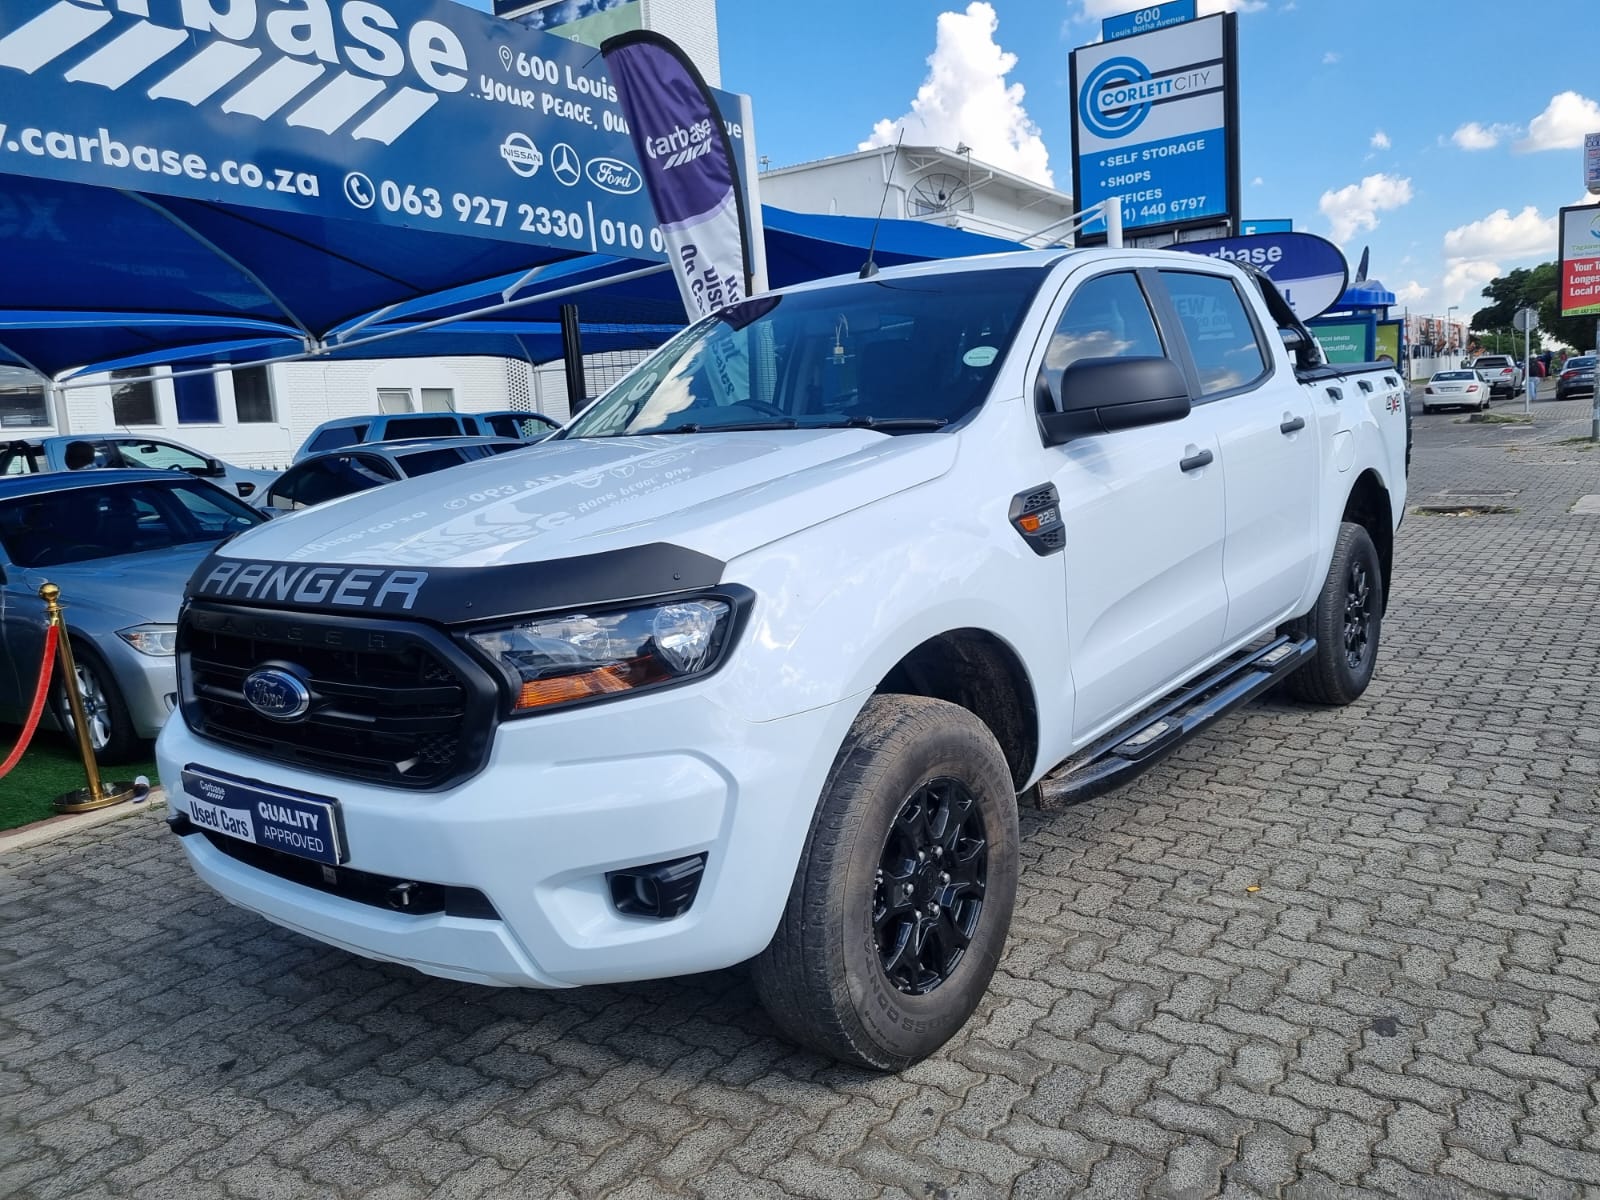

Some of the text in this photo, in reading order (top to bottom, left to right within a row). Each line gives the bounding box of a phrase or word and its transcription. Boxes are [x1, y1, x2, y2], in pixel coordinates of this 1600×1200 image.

[1111, 15, 1186, 39] Louis Botha Avenue
[1134, 8, 1161, 25] 600
[517, 53, 618, 103] 600 Louis
[646, 117, 711, 159] Carbase
[503, 147, 541, 161] NISSAN
[1107, 139, 1206, 167] SELF STORAGE
[596, 162, 632, 188] Ford
[1107, 170, 1151, 187] SHOPS
[380, 180, 442, 218] 063
[453, 193, 509, 227] 927
[1119, 188, 1162, 204] FFICES
[1140, 203, 1166, 216] 440
[1170, 196, 1206, 212] 6797
[1574, 261, 1593, 272] Your
[1570, 285, 1593, 297] Local
[199, 561, 429, 610] RANGER
[251, 677, 288, 710] Ford
[189, 800, 249, 838] Used Cars
[258, 801, 319, 831] QUALITY
[264, 824, 324, 853] APPROVED
